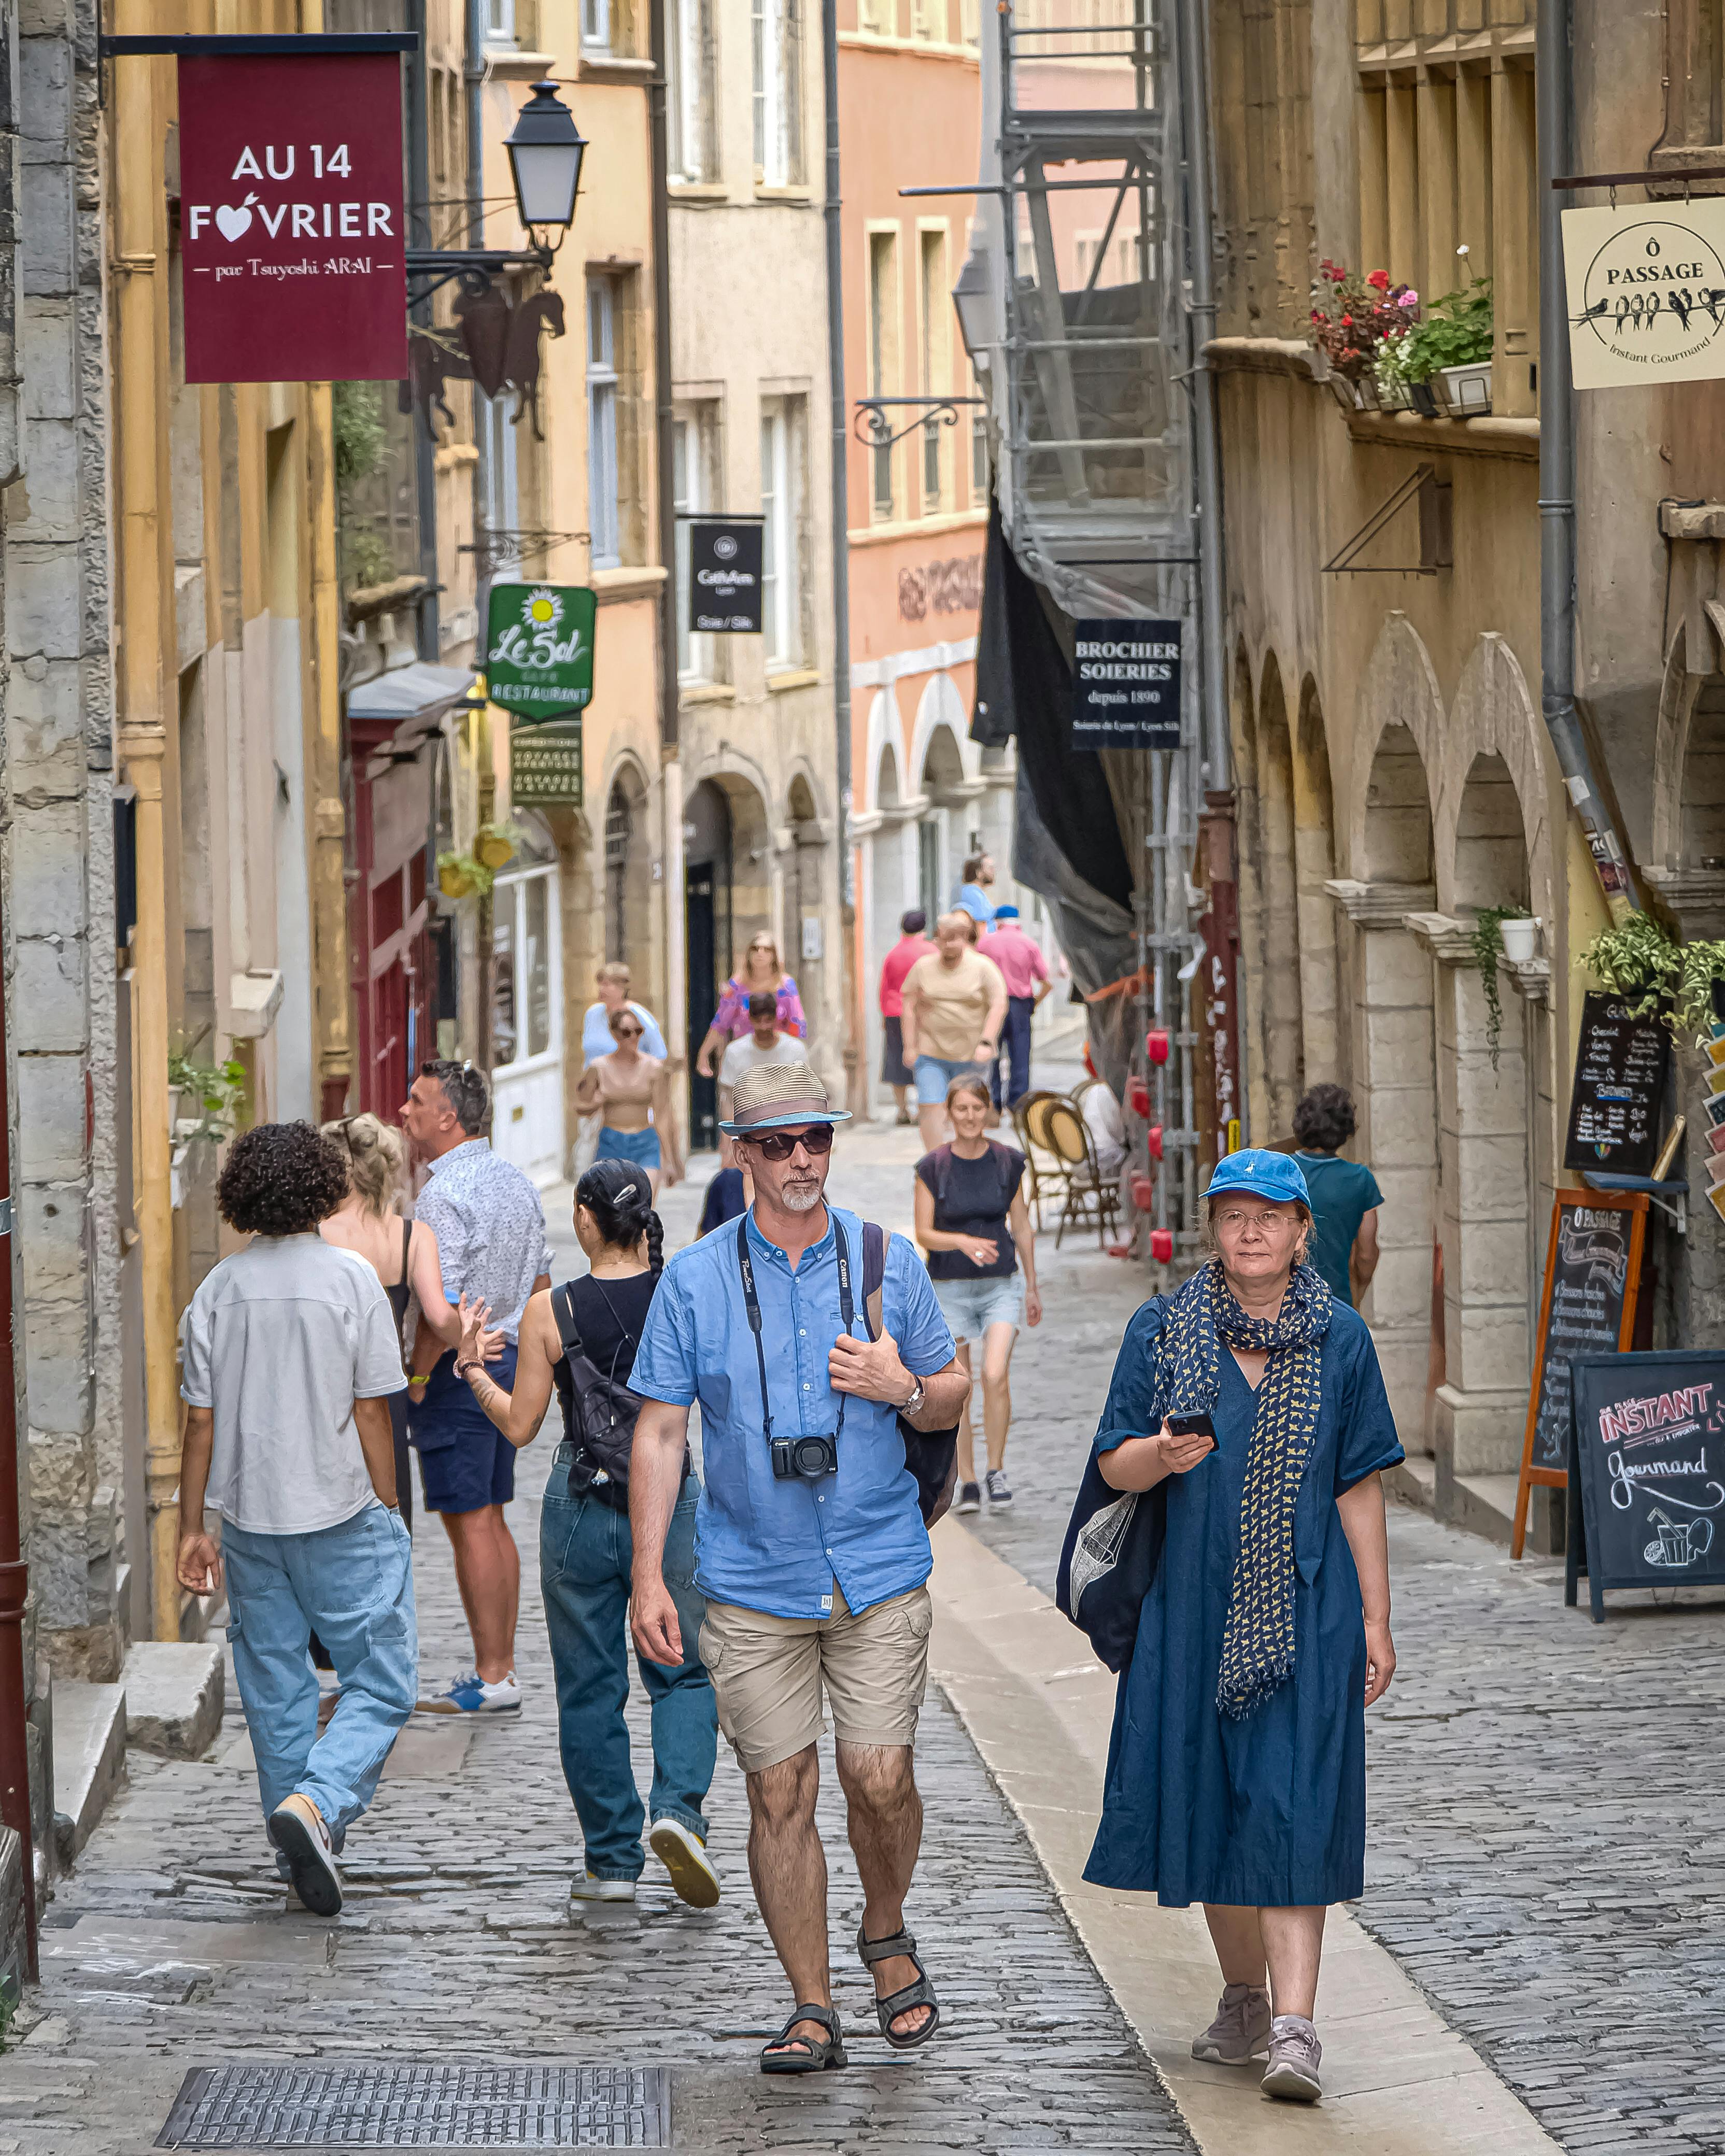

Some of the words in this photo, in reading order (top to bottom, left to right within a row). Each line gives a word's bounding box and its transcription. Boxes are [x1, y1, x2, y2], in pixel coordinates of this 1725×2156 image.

[231, 146, 295, 180] AU
[310, 145, 352, 178] 14
[1645, 236, 1660, 257] Ô
[216, 265, 243, 281] par
[247, 259, 319, 281] Tsuyoshi
[324, 257, 371, 274] ARAI
[1606, 262, 1703, 285] PASSAGE
[1609, 344, 1647, 363] Instant
[1651, 336, 1711, 364] Gourmand
[1076, 642, 1179, 659] BROCHIER
[1080, 663, 1172, 680] SOIERIES
[491, 684, 589, 703] RESTAURANT
[1088, 690, 1128, 706] depuis
[1599, 1383, 1713, 1443] INSTANT
